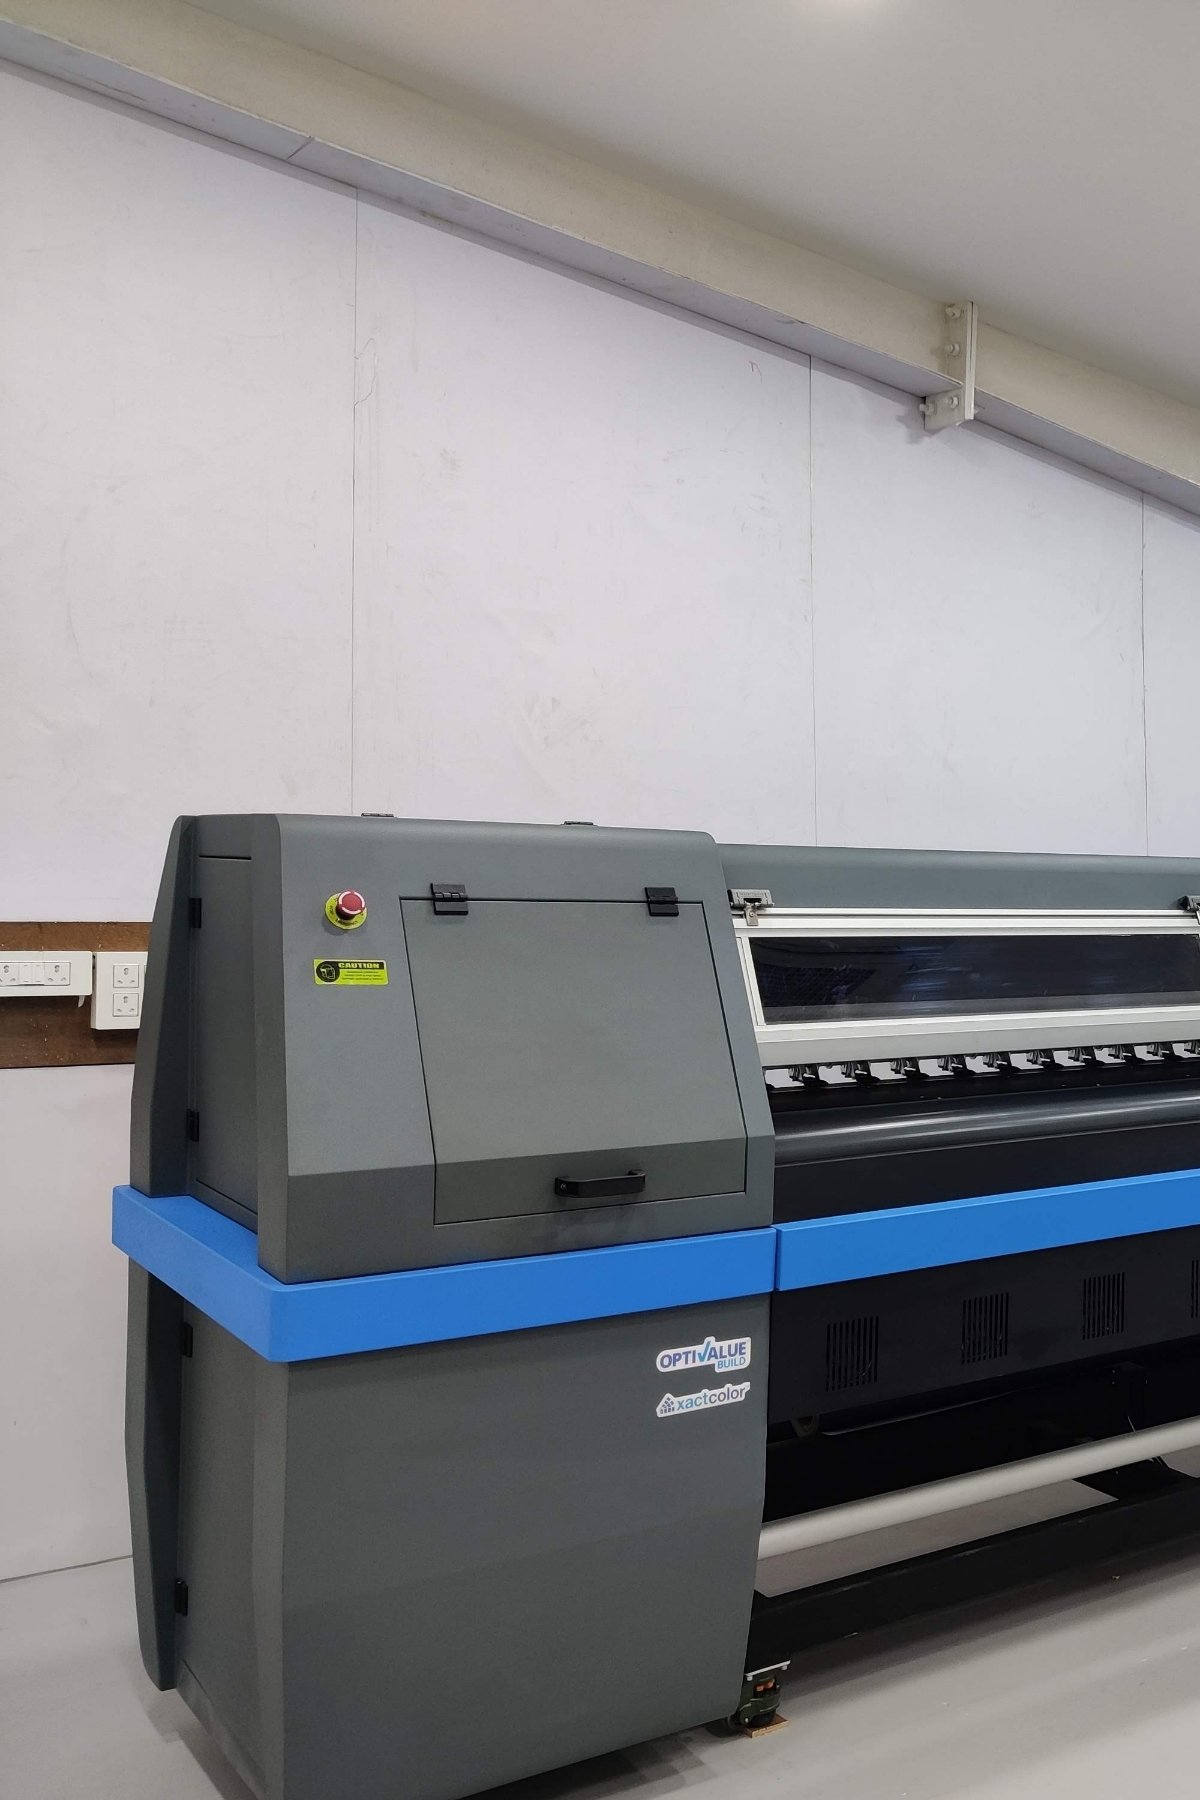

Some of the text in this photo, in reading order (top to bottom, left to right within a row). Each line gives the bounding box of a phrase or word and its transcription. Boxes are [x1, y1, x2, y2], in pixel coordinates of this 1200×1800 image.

[660, 1341, 747, 1369] OPTIVALUE
[717, 1356, 746, 1369] BUILD
[676, 1387, 746, 1411] xactcolor
